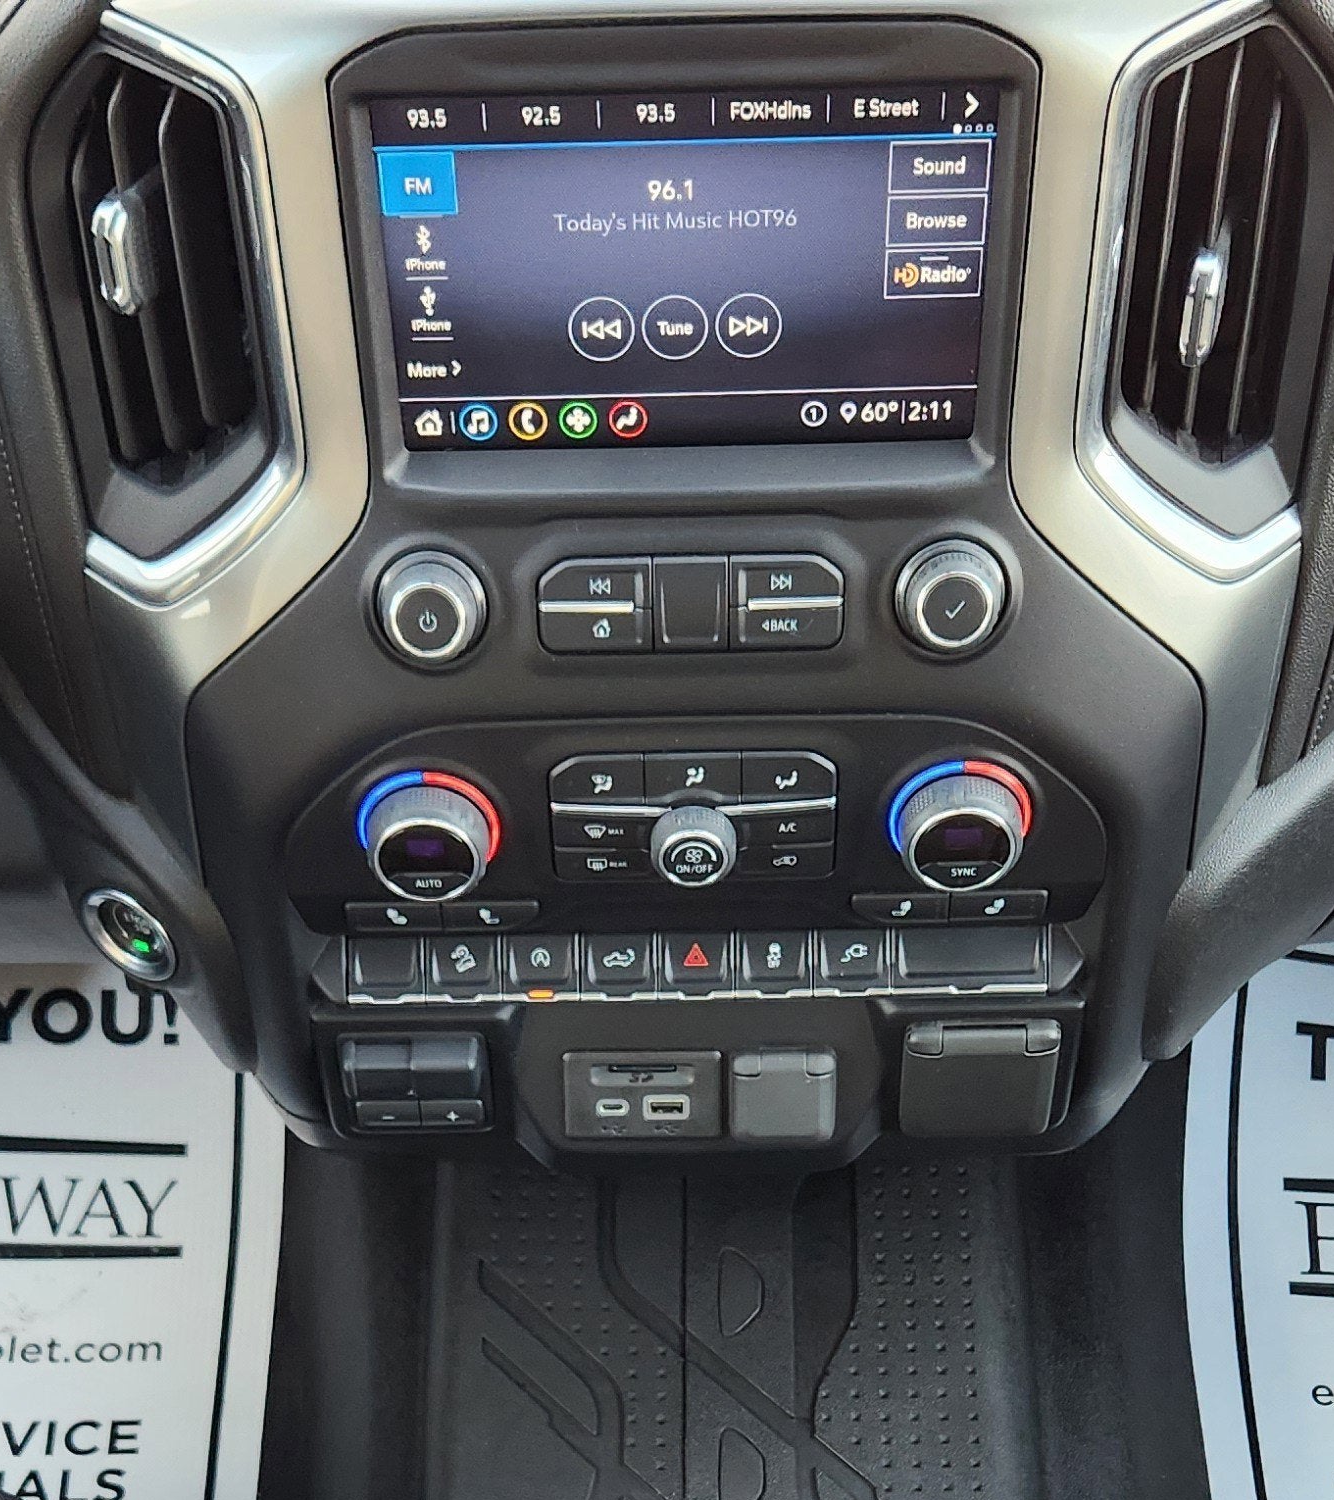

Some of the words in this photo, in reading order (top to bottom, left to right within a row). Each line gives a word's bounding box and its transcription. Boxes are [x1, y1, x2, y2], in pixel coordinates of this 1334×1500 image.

[521, 105, 561, 126] 92.5
[635, 102, 676, 122] 93.5
[853, 99, 866, 119] E
[869, 98, 919, 118] Street
[406, 108, 447, 129] 93.5
[913, 156, 966, 176] Sound
[404, 178, 432, 195] FM
[647, 179, 694, 201] 96.1
[554, 213, 627, 237] Today's
[632, 213, 660, 231] Hit
[666, 210, 722, 229] Music
[729, 208, 797, 229] HOT96
[905, 212, 967, 230] Browse
[405, 257, 447, 272] iPhone
[657, 320, 694, 336] Tune
[407, 361, 448, 379] More
[908, 400, 953, 422] 2:11
[770, 618, 798, 632] BACK
[608, 827, 624, 836] MAX
[778, 821, 797, 834] A/C
[676, 863, 714, 875] ON/OFF
[950, 866, 978, 878] SYNC
[415, 878, 443, 889] AUTO
